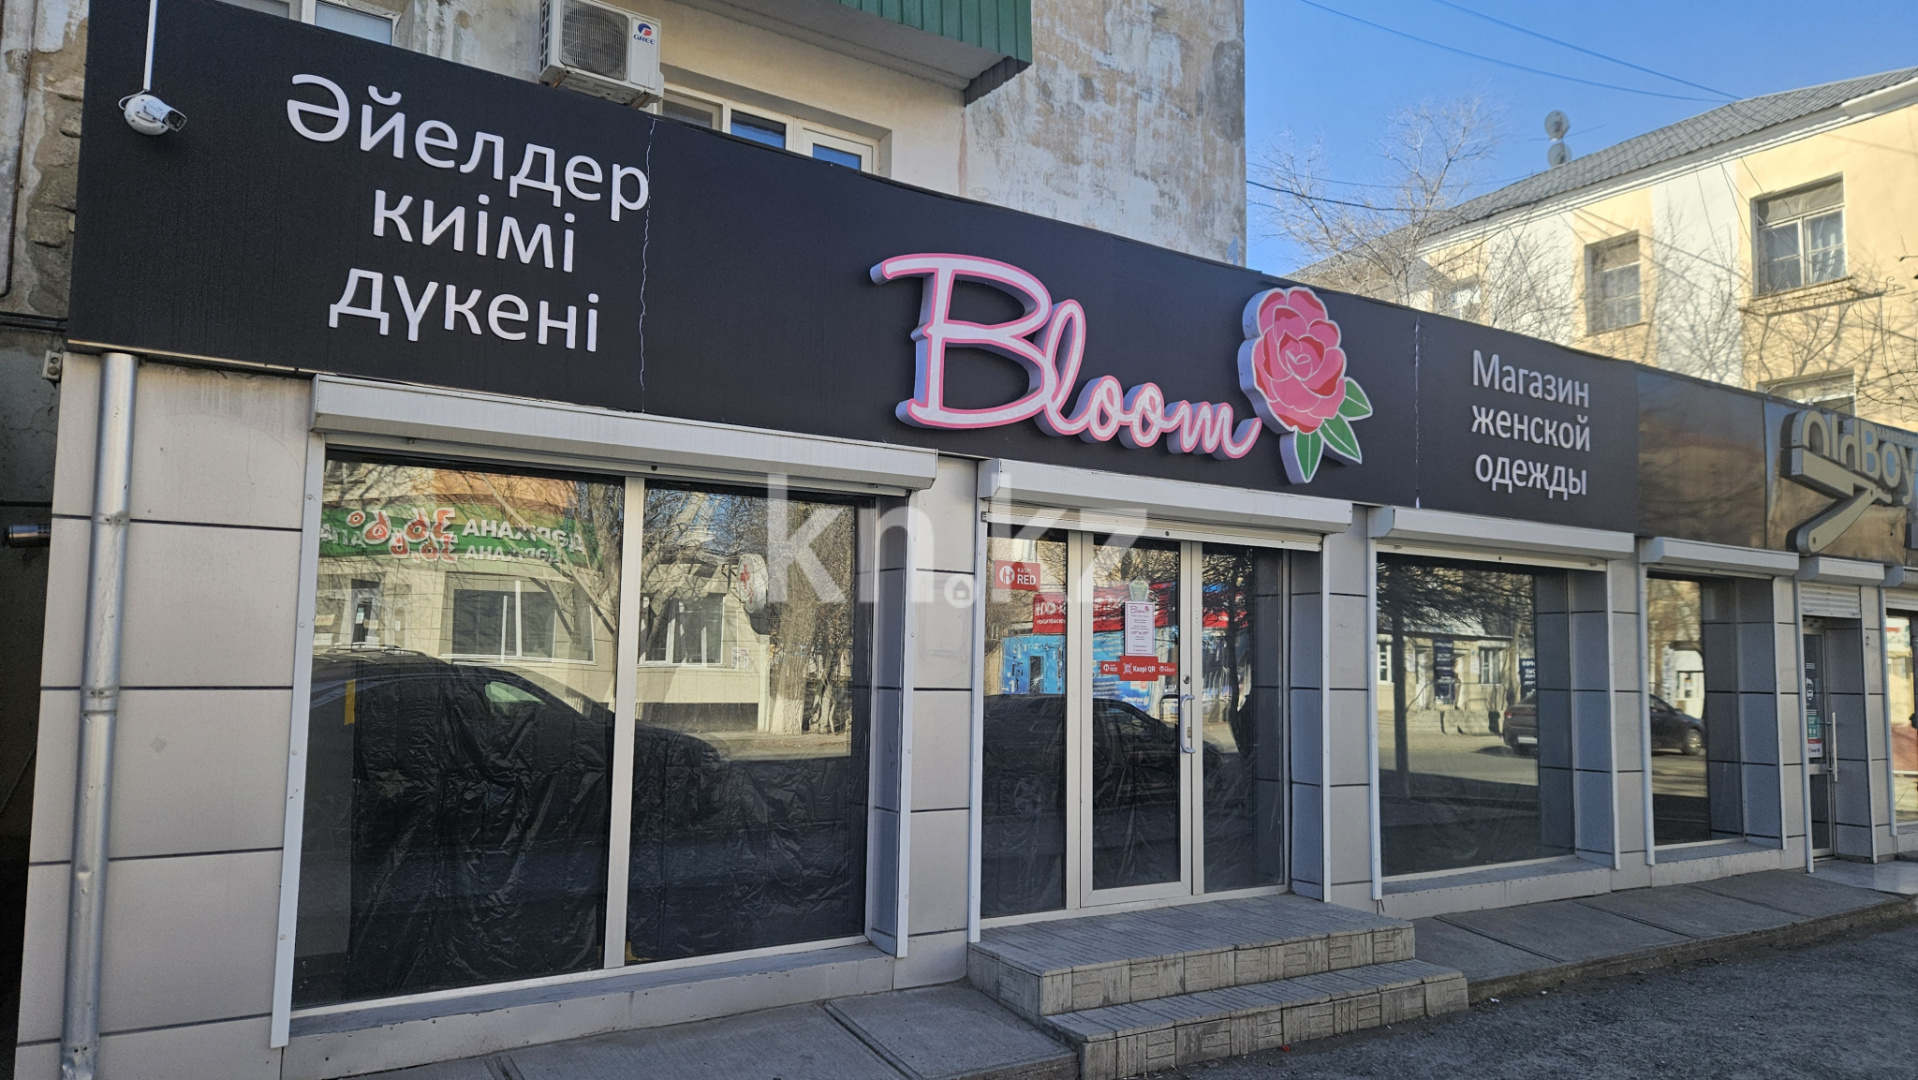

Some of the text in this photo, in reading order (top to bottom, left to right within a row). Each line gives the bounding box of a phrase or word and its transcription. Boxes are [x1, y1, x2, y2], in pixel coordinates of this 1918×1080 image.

[633, 34, 655, 45] GREE
[287, 73, 650, 222] Әйелдер
[373, 189, 576, 273] киімі
[328, 268, 600, 353] дүкені
[872, 252, 1262, 459] Bloom
[1473, 349, 1590, 408] Магазин
[1471, 405, 1591, 452] женской
[1474, 453, 1587, 501] одежды
[1016, 574, 1037, 586] RED
[1132, 665, 1148, 674] Kaspi
[1148, 665, 1156, 673] QR
